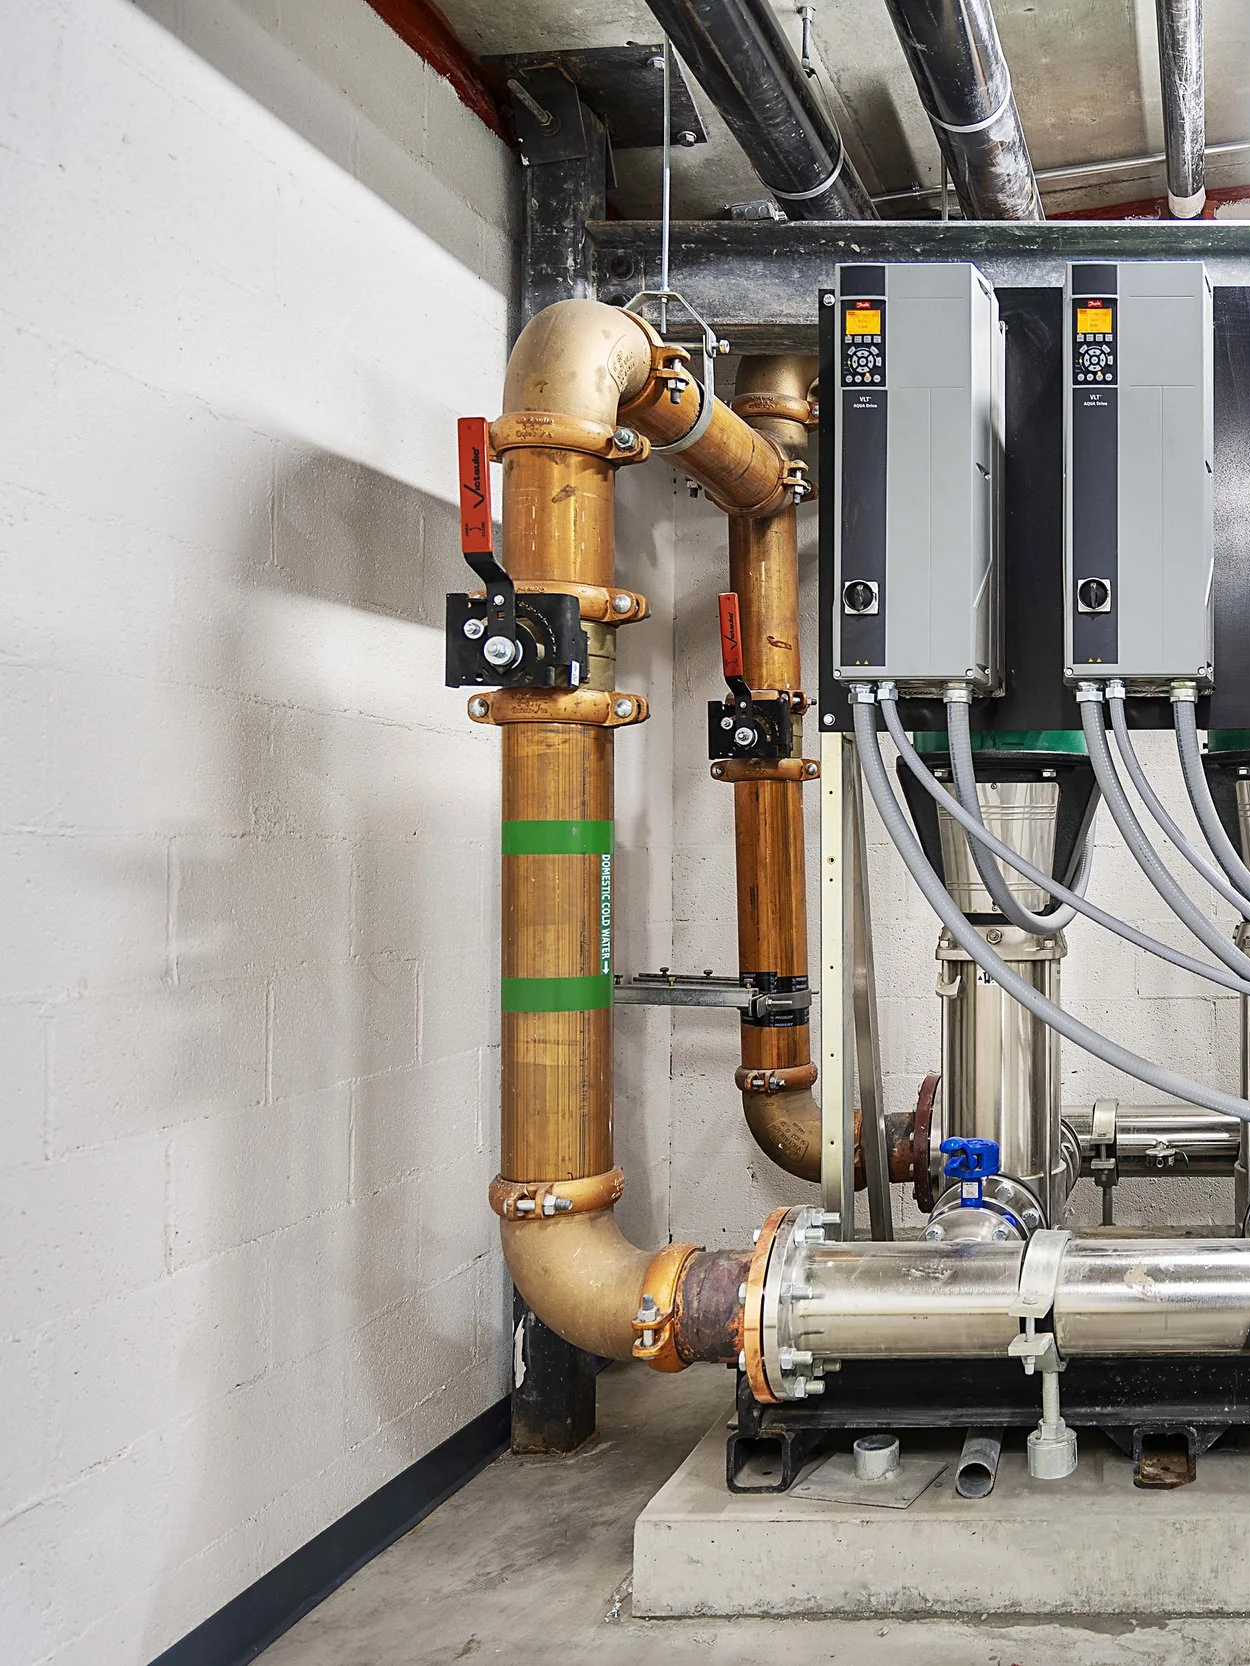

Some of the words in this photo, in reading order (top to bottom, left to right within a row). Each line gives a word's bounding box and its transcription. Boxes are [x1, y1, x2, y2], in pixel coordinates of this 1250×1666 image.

[463, 448, 485, 509] Victaulic
[601, 854, 611, 900] DOMESTIC
[601, 902, 611, 927] COLD
[601, 929, 611, 960] WATER
